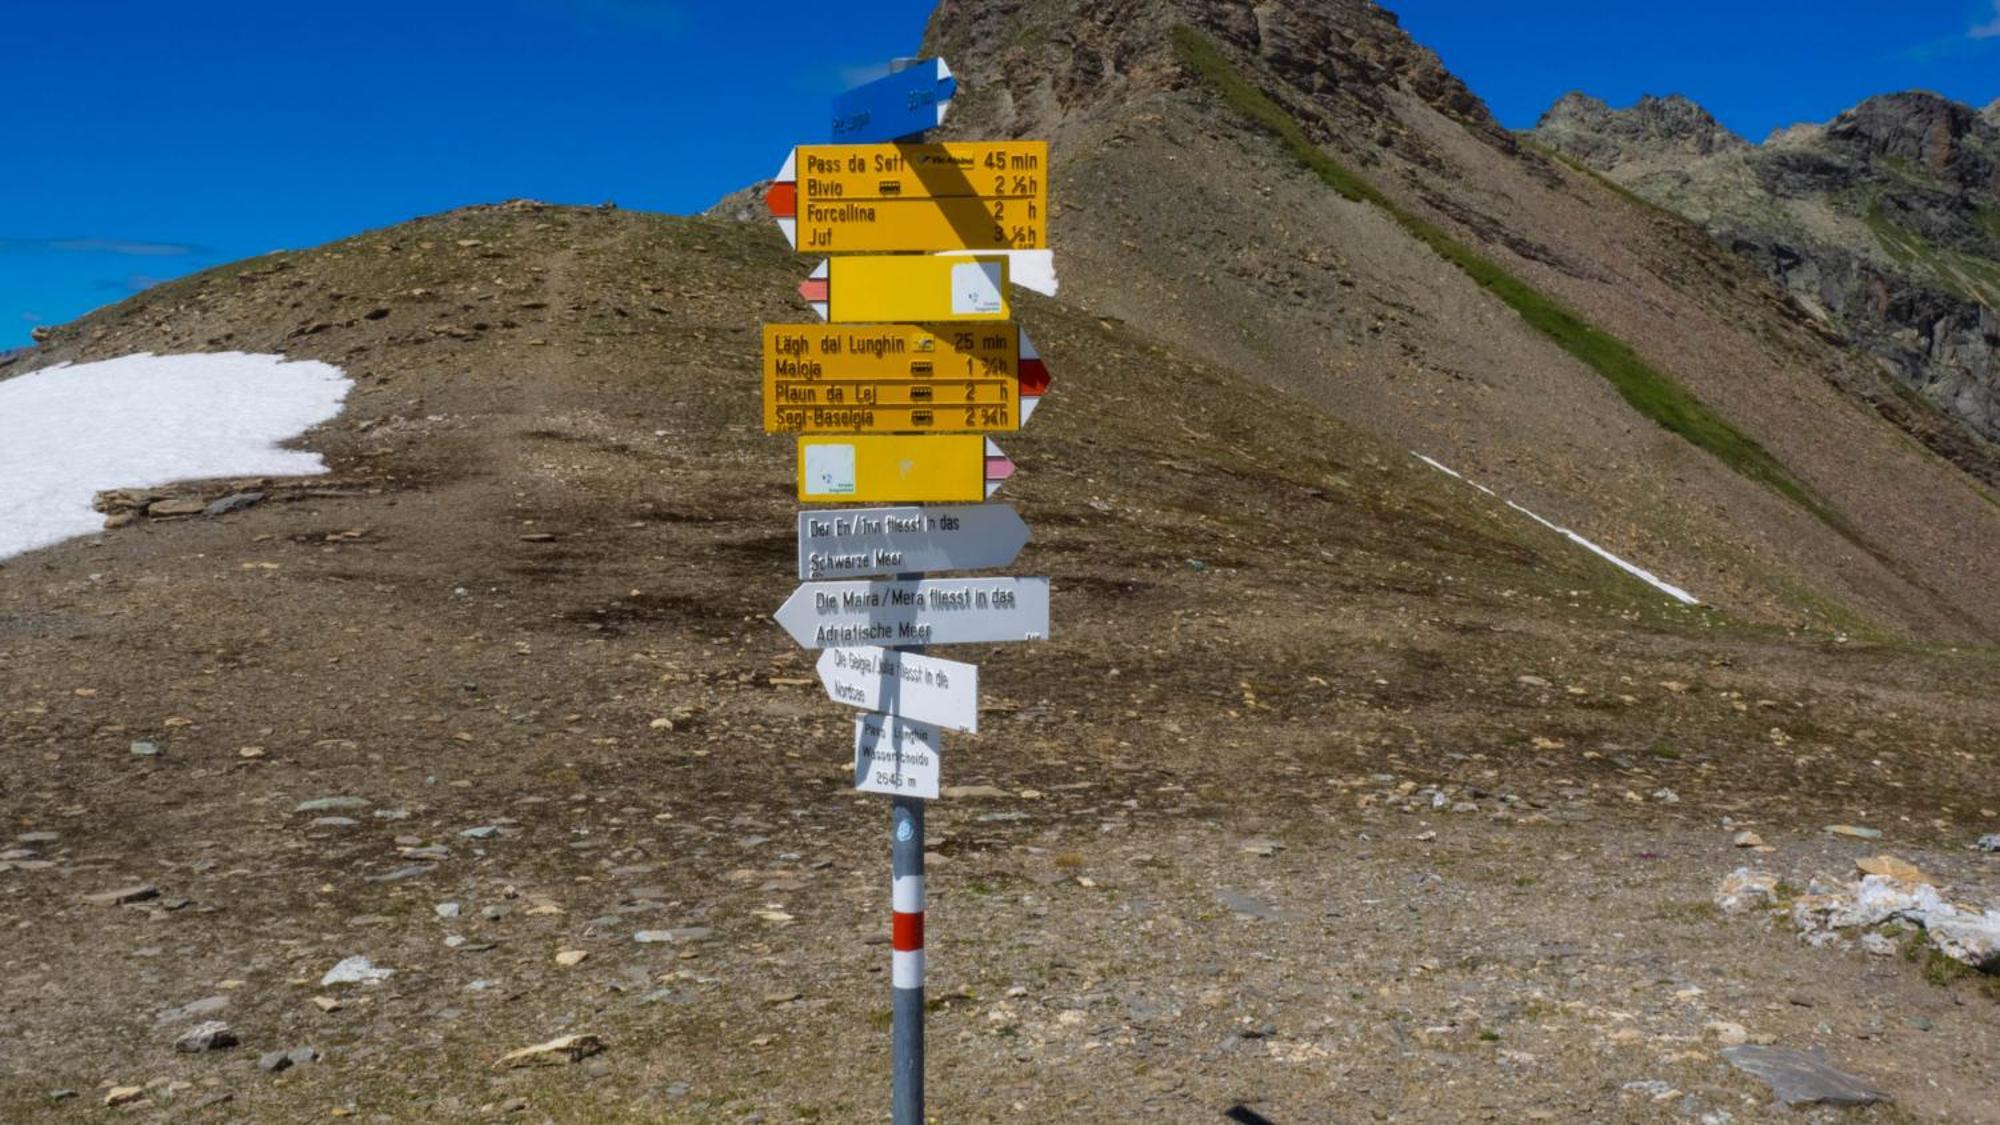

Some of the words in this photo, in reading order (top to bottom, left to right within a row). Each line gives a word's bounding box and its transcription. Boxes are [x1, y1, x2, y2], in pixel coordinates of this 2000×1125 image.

[808, 155, 841, 173] Pass
[848, 154, 866, 173] da
[874, 153, 904, 173] Sett
[984, 151, 1006, 170] 45
[1011, 153, 1037, 170] min
[808, 178, 843, 196] Bivio
[994, 175, 1005, 194] 2
[808, 203, 876, 222] Forcellina
[994, 201, 1004, 221] 2
[1028, 201, 1036, 220] h
[808, 227, 832, 246] Juf
[994, 225, 1004, 242] 3
[775, 334, 809, 357] Lägh
[821, 335, 841, 354] dal
[849, 335, 905, 359] Lunghin
[954, 332, 974, 353] 25
[982, 334, 1007, 350] min
[775, 359, 822, 381] Maloja
[966, 357, 973, 376] 1
[775, 383, 816, 402] Plaun
[826, 384, 843, 402] da
[855, 384, 877, 405] Lej
[965, 382, 975, 401] 2
[1000, 382, 1008, 400] h
[965, 406, 975, 427] 2
[809, 518, 830, 538] Der
[885, 514, 921, 533] fliesst
[924, 514, 936, 533] in
[939, 514, 960, 531] das
[809, 551, 869, 572] Schwarze
[873, 548, 903, 569] Meer
[816, 591, 837, 610] Die
[929, 587, 971, 608] fliesst
[975, 588, 988, 607] in
[991, 587, 1016, 606] das
[816, 621, 892, 642] Adriatische
[899, 621, 932, 640] Meer
[834, 649, 847, 668] Die
[925, 669, 934, 688] in
[935, 669, 949, 690] die
[834, 679, 866, 703] Nordsee
[864, 723, 886, 739] Pass
[894, 726, 928, 745] Lunghin
[863, 746, 929, 767] Wasserscheide
[876, 771, 903, 787] 2645
[908, 777, 917, 787] m
